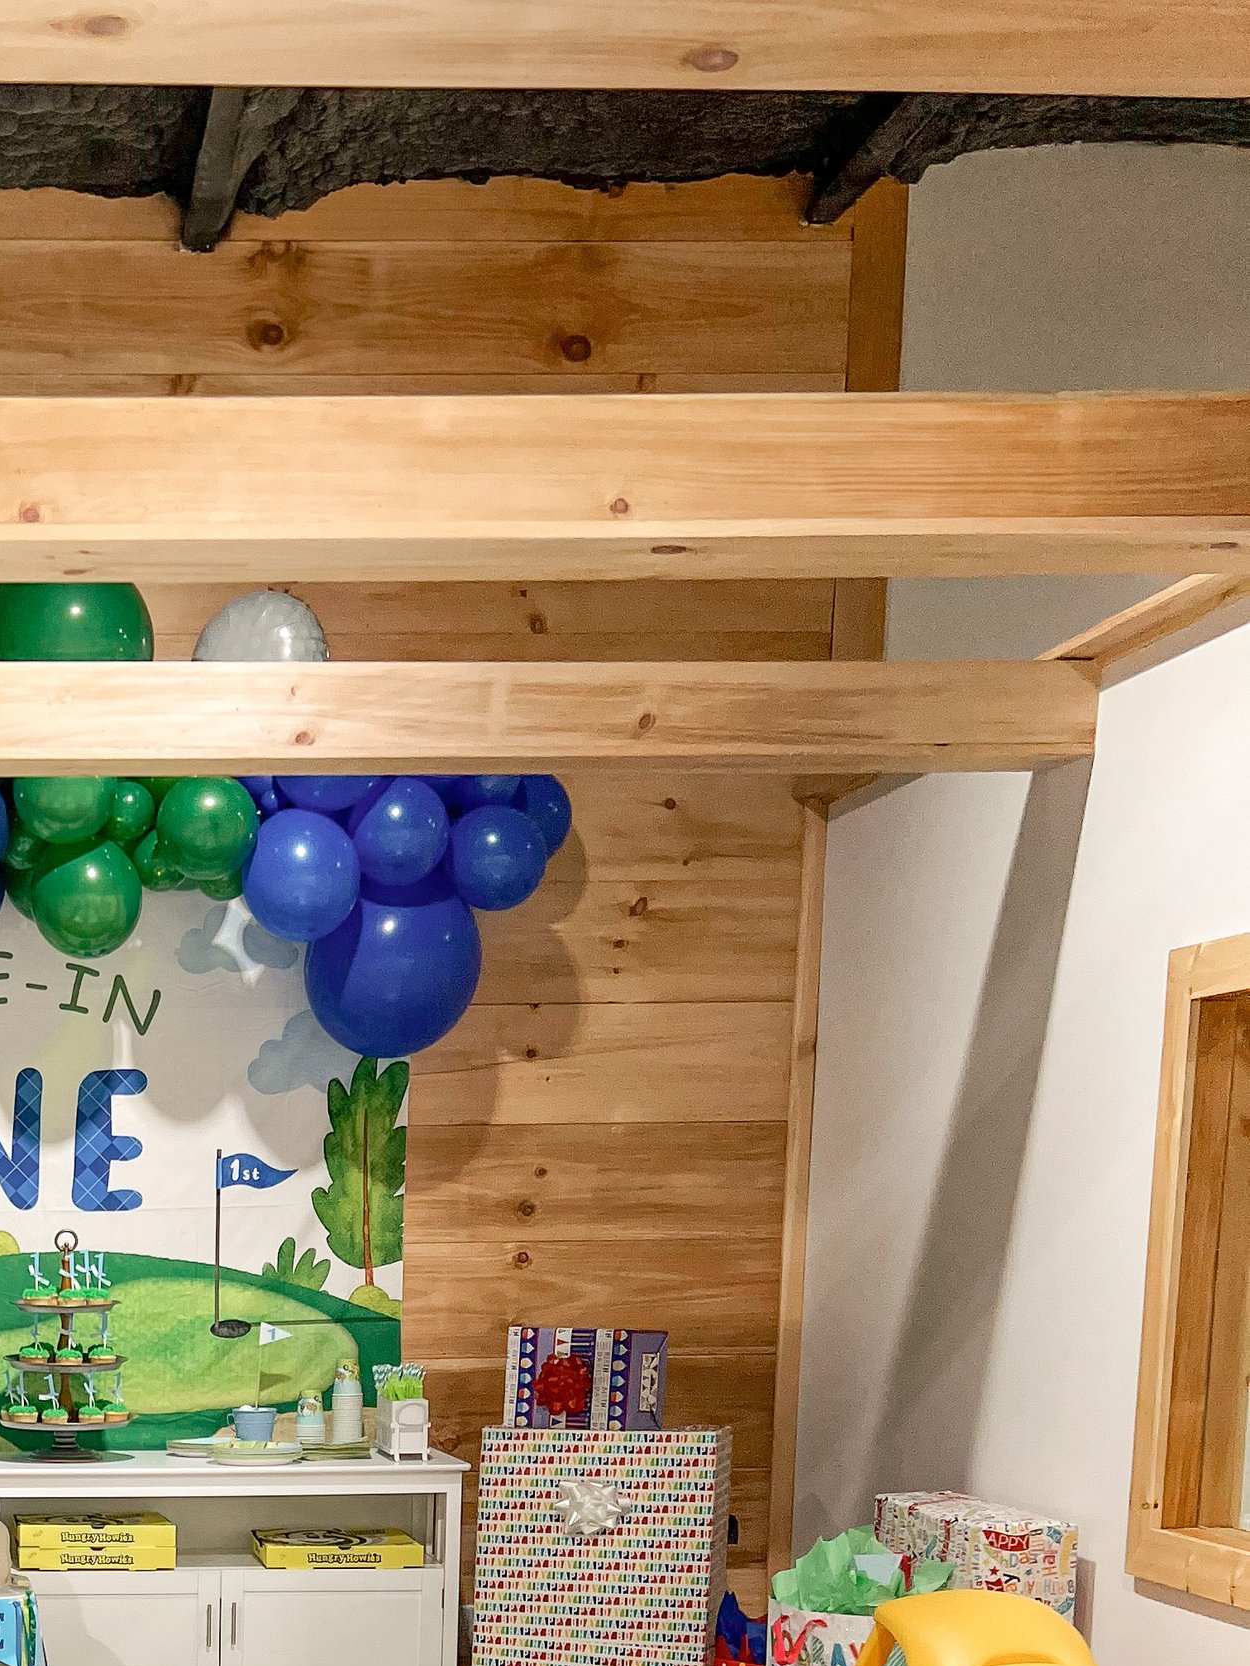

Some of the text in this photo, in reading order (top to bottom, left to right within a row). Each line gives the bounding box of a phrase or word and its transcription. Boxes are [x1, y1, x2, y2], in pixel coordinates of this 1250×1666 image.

[230, 1158, 260, 1182] 1st
[267, 1327, 277, 1341] 1
[61, 1532, 99, 1543] Hungry
[60, 1553, 98, 1565] Hungry
[307, 1552, 346, 1565] Hungry
